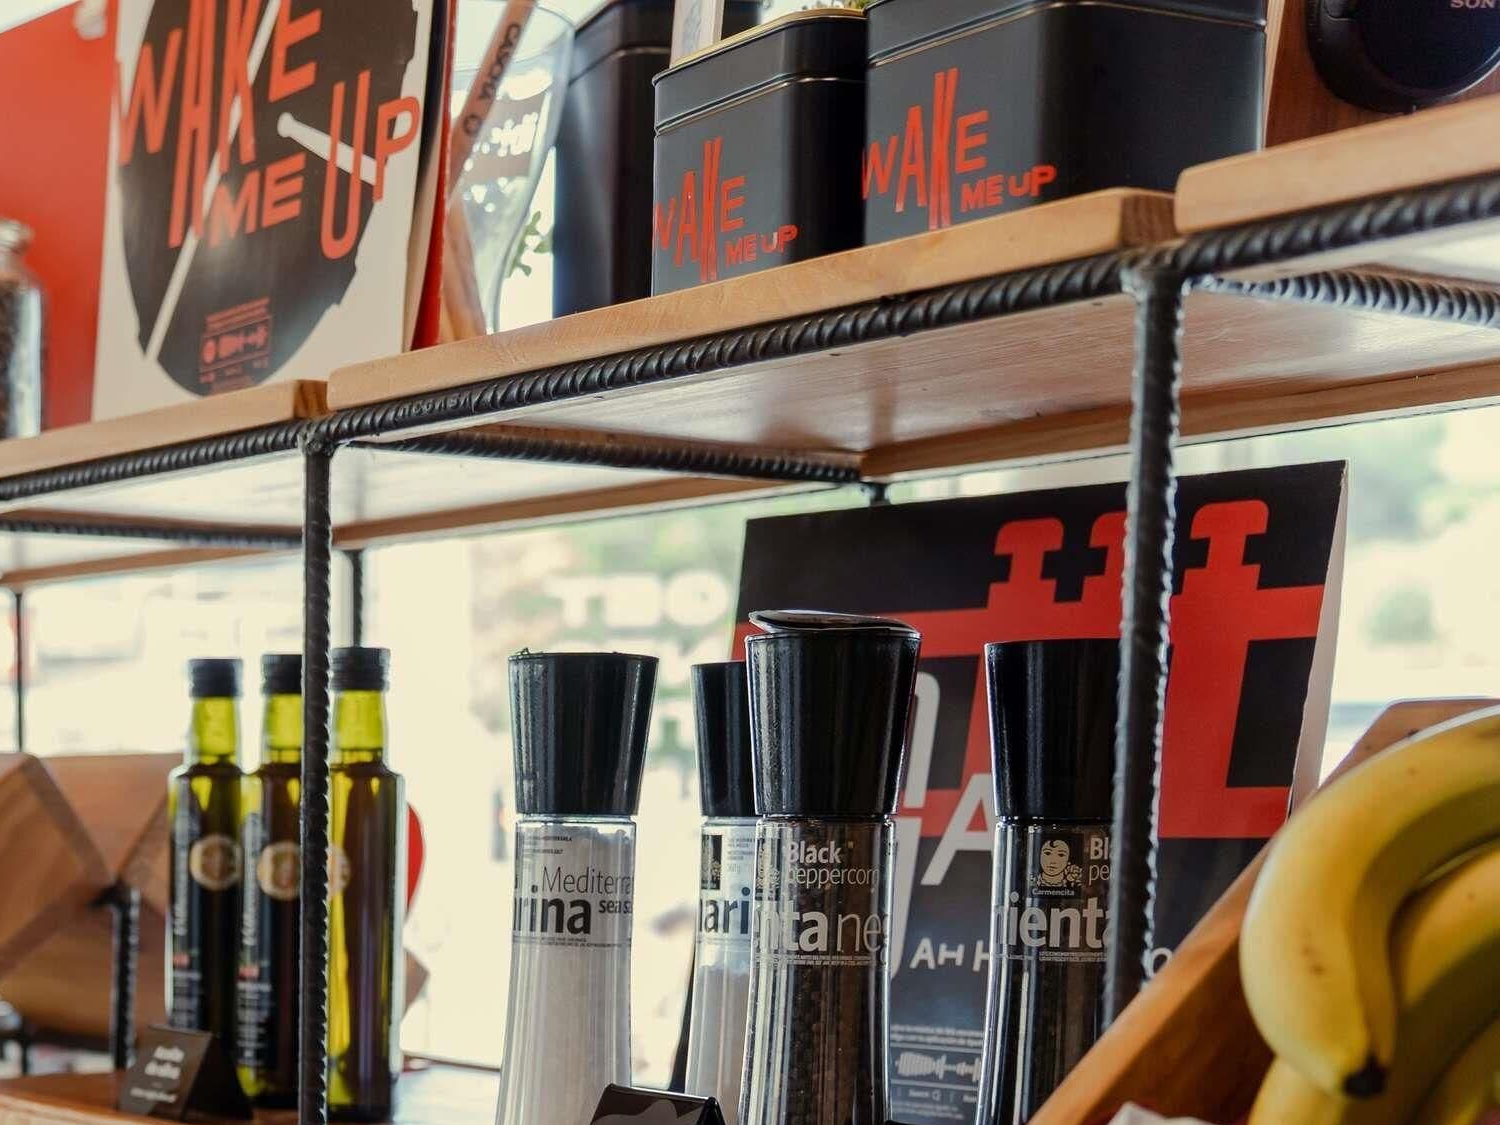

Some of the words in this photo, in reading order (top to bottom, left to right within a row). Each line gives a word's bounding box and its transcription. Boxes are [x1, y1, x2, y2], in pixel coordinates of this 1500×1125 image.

[1450, 0, 1500, 9] SON
[210, 151, 307, 249] ME
[320, 69, 421, 260] UP
[959, 173, 1005, 213] ME
[1008, 164, 1057, 197] UP
[724, 233, 758, 268] ME
[762, 224, 799, 253] UP
[786, 840, 841, 863] Black
[1031, 887, 1075, 896] Carmencita
